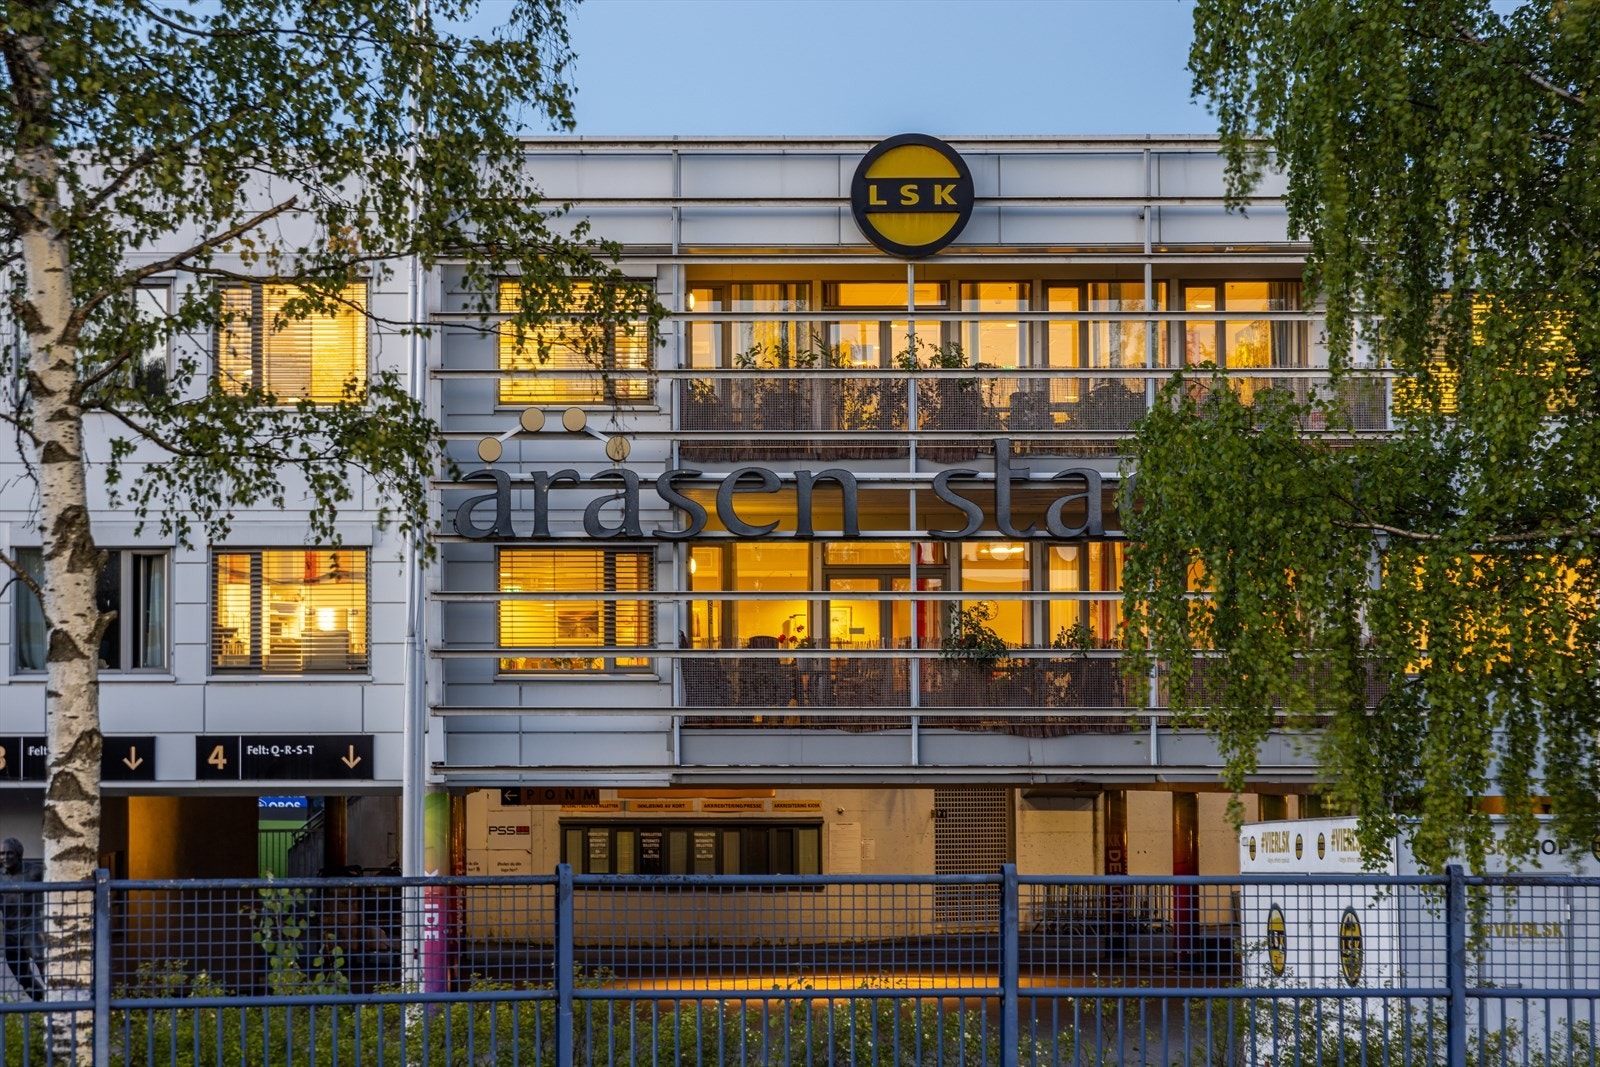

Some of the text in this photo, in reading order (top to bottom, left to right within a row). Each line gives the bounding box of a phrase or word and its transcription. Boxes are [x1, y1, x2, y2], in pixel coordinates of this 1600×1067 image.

[868, 184, 958, 206] LSK
[207, 744, 228, 770] 4
[246, 745, 315, 757] Felt: Q-R-S-T
[526, 788, 596, 800] P O N M
[488, 825, 516, 835] PSS
[1261, 831, 1290, 853] #VIERLSK
[1108, 850, 1123, 914] DEIGN
